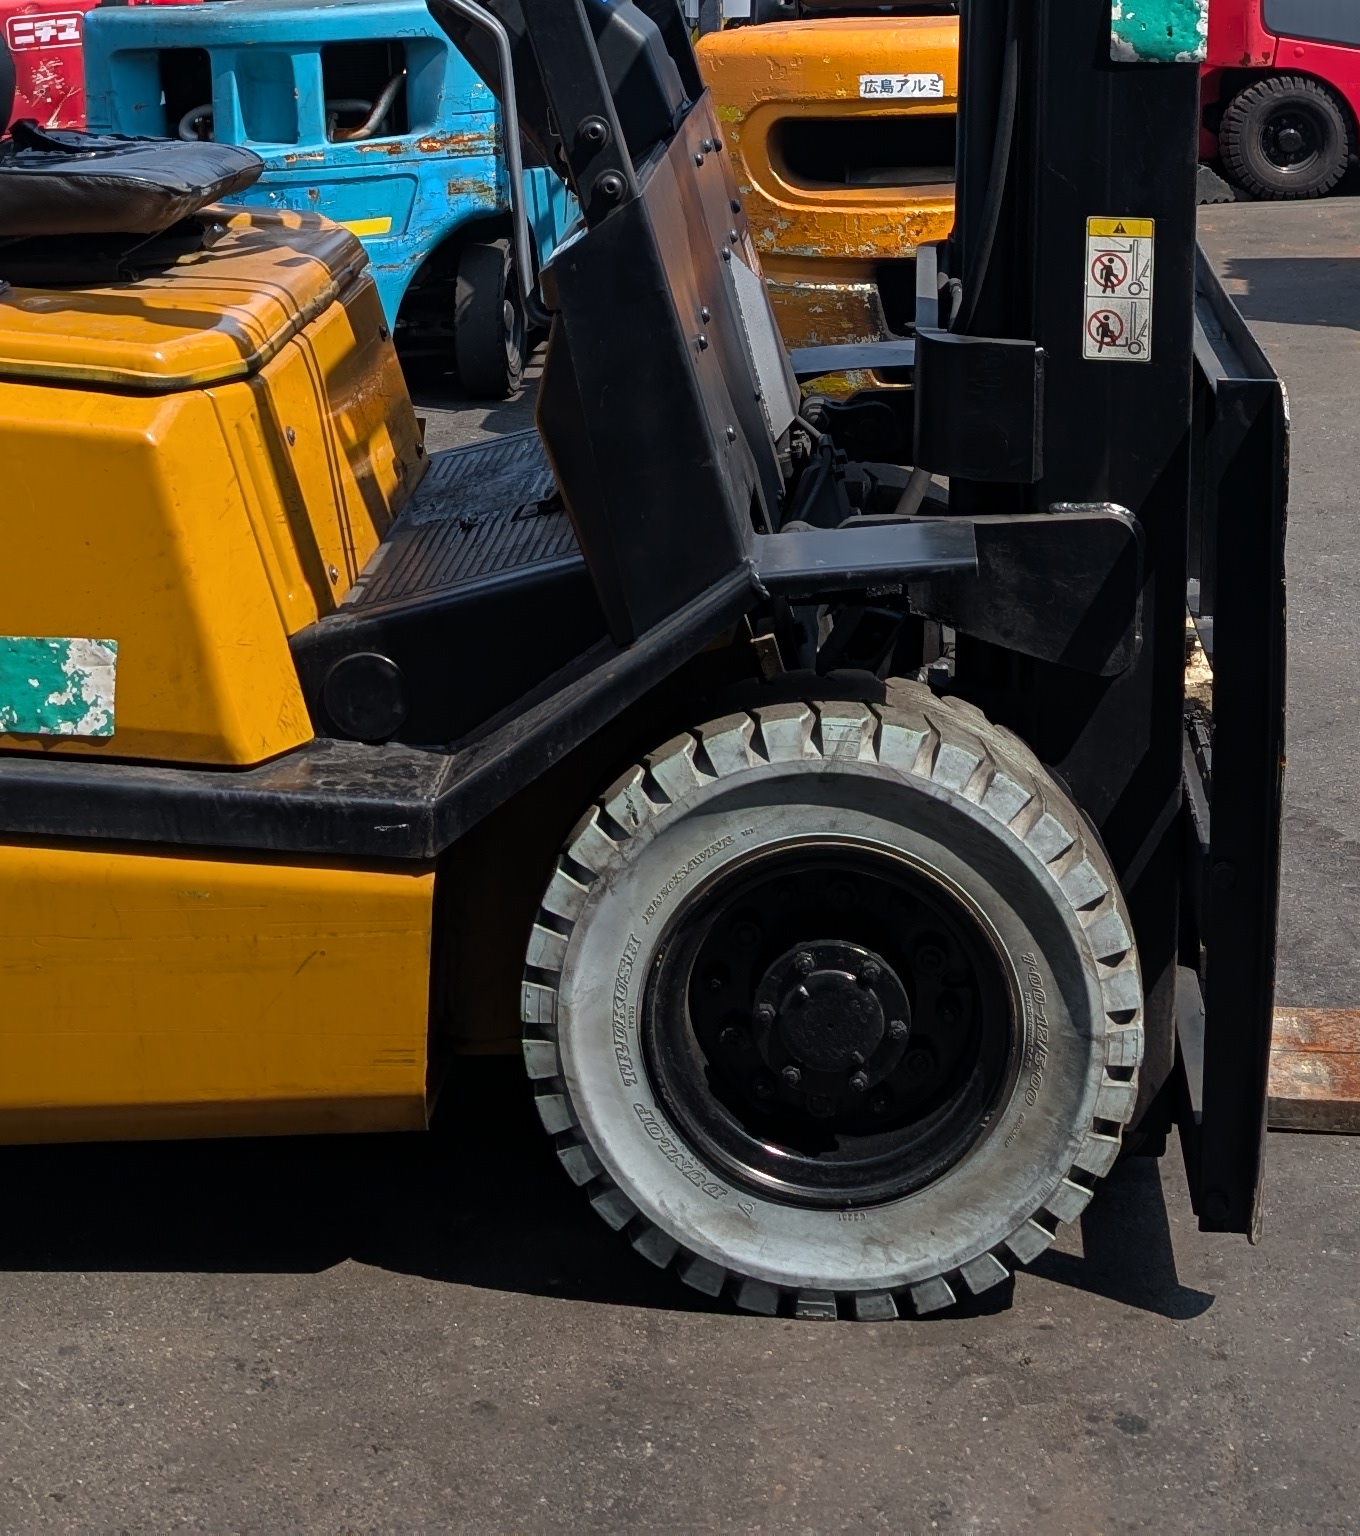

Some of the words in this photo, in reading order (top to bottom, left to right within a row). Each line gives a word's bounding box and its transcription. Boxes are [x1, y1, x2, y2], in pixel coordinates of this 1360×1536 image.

[13, 17, 80, 44] ニチユ
[863, 78, 941, 94] 広島アルミ
[612, 931, 642, 1087] TRUKUSH
[633, 1102, 729, 1200] DUNLOP
